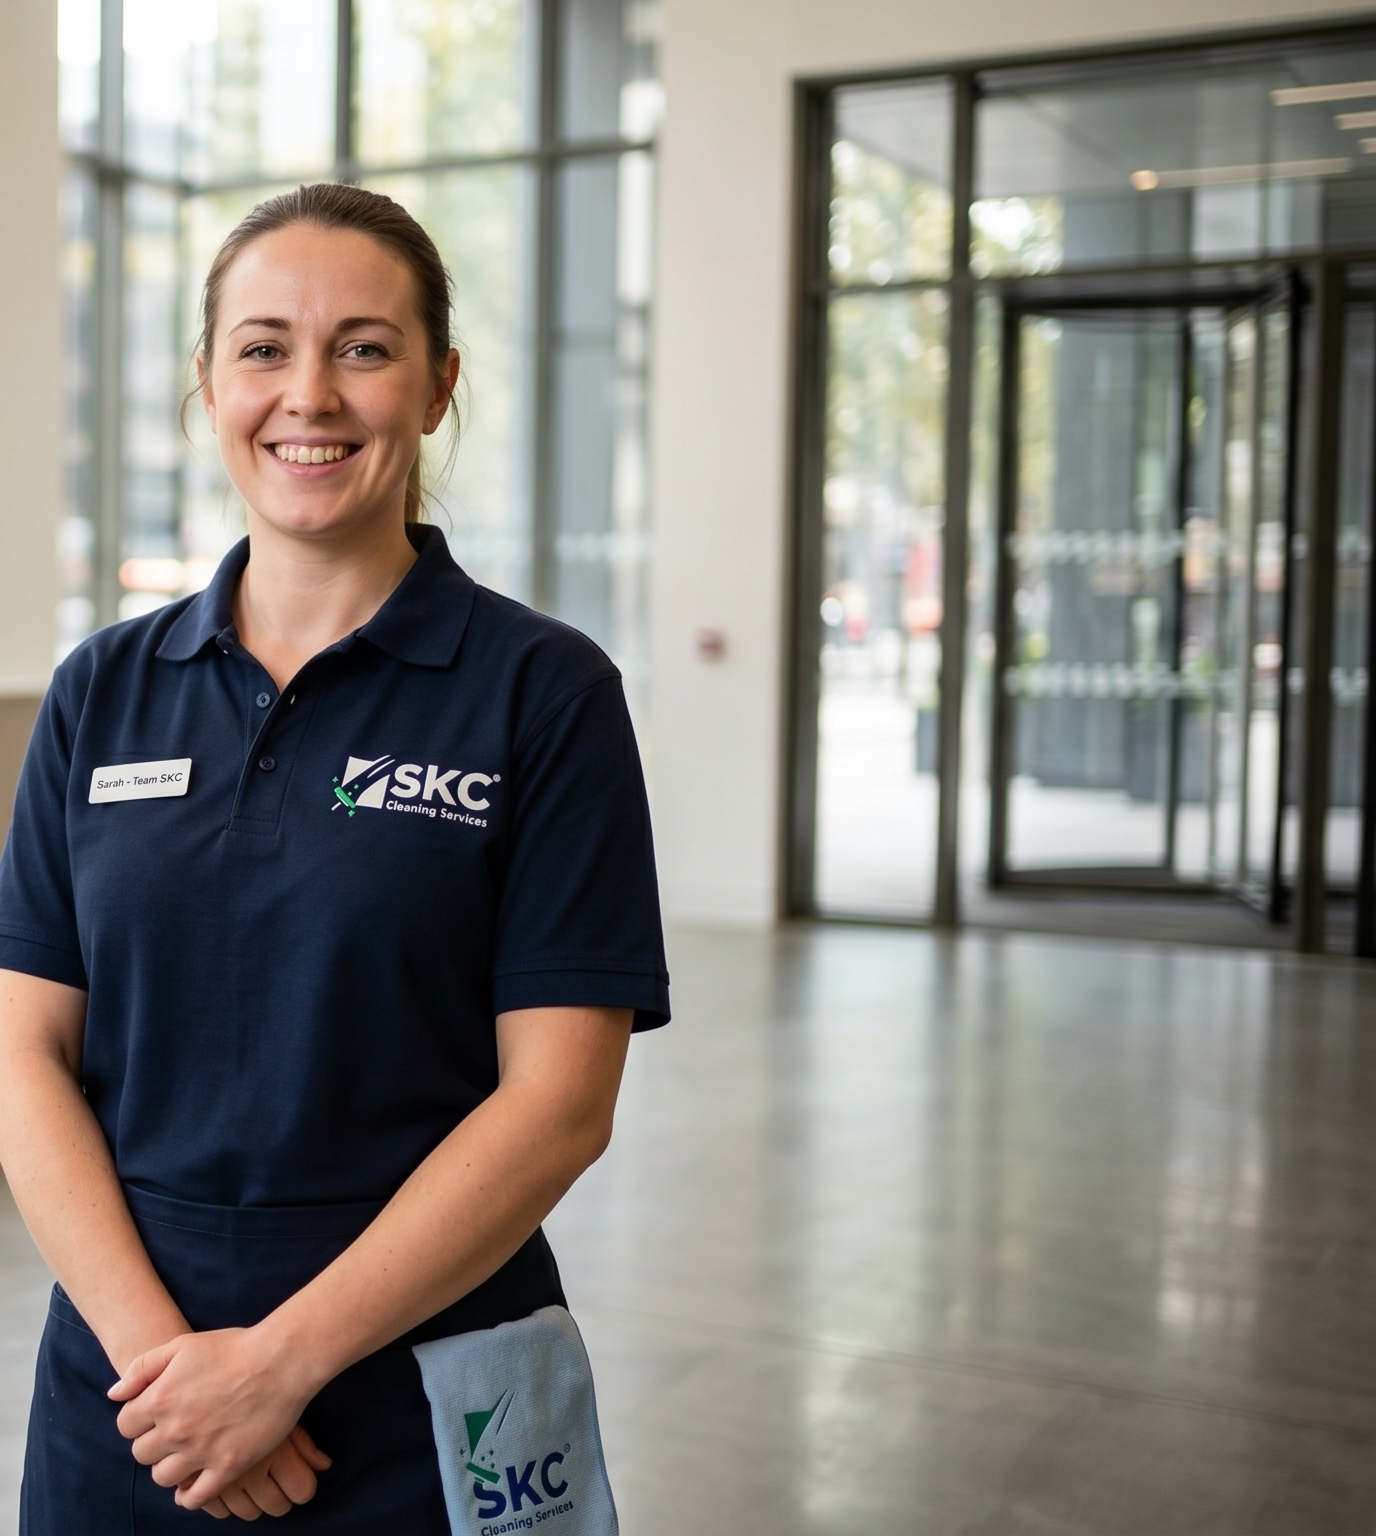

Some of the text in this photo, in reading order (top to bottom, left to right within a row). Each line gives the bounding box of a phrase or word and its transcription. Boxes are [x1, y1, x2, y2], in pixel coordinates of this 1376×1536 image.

[96, 778, 124, 789] Sarah
[133, 776, 158, 786] Team
[160, 772, 183, 783] SKC
[386, 800, 488, 828] Cleaning Services
